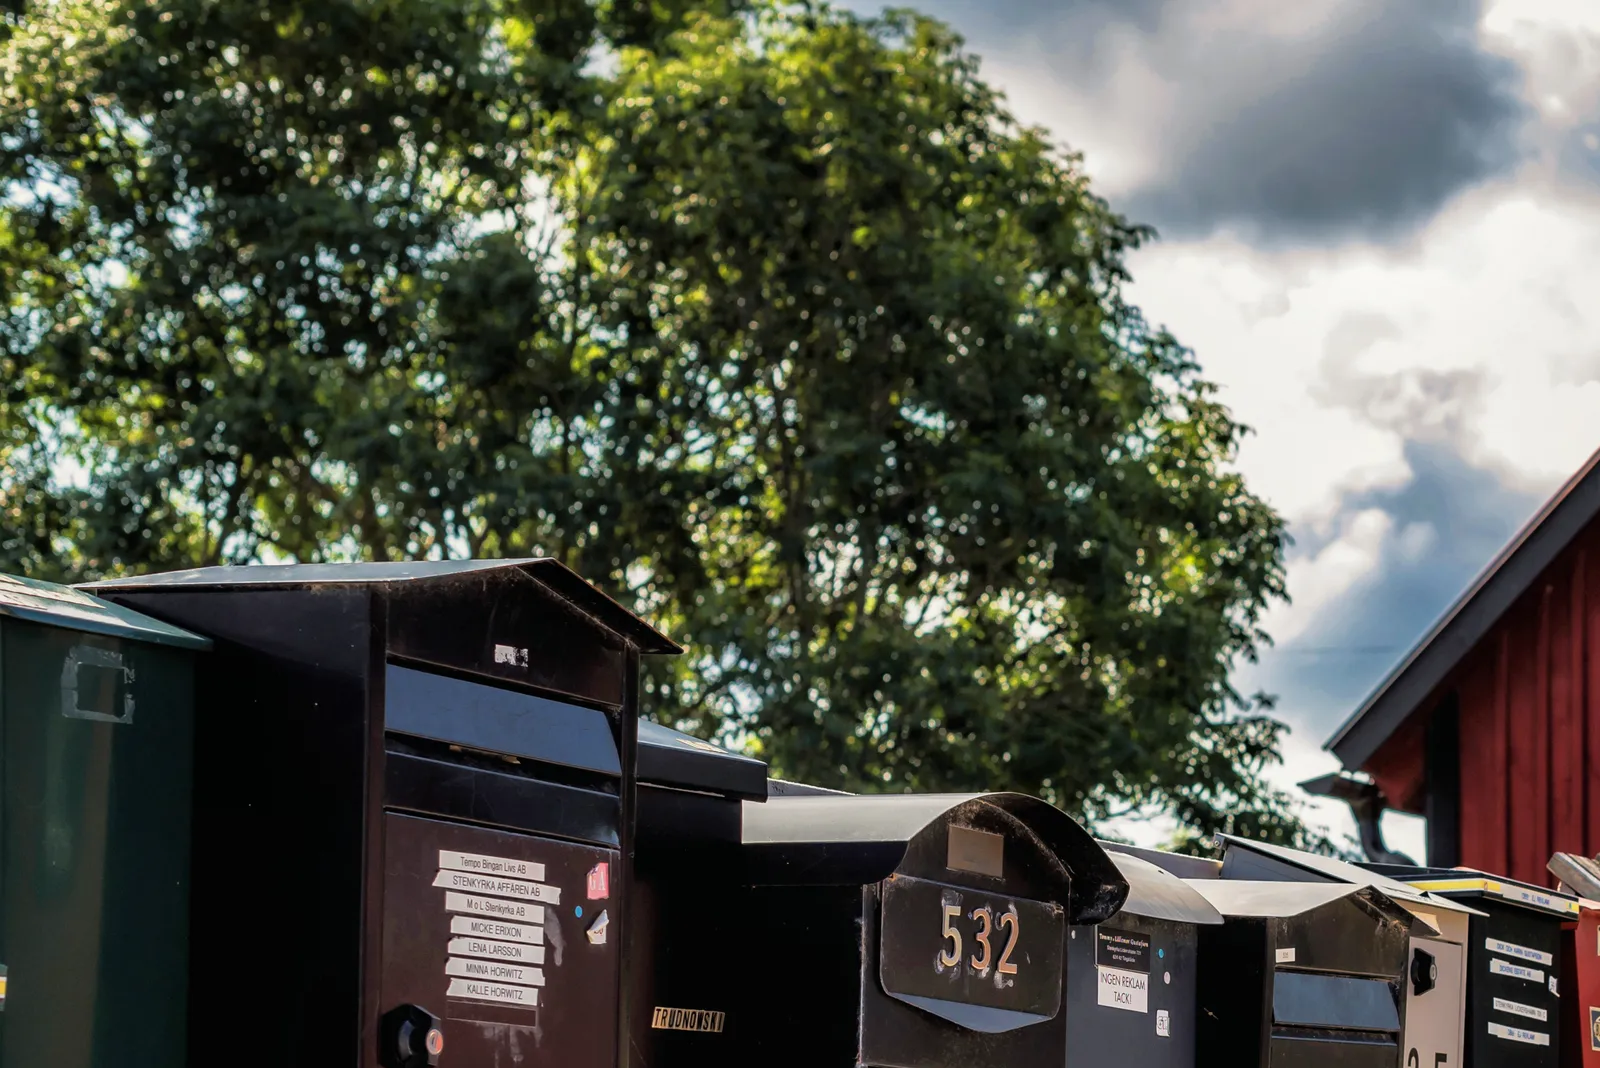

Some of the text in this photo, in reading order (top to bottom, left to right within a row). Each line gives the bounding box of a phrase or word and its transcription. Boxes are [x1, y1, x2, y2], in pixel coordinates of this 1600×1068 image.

[460, 856, 526, 874] Tempo Bingan Livs AB
[453, 875, 495, 891] STENKYRKA
[530, 886, 540, 897] AB
[467, 898, 473, 908] M
[474, 902, 479, 910] o
[485, 901, 514, 916] Stenkyrka
[516, 906, 525, 916] AB
[471, 922, 521, 938] MICKE ERIXON
[940, 905, 1019, 974] 532
[468, 942, 522, 957] LENA LARSSON
[466, 963, 523, 979] MINNA HORWITZ
[1101, 972, 1146, 991] INGEN REKLAM
[467, 984, 523, 1000] KALLE HORWITZ
[1114, 991, 1132, 1005] TACK!
[654, 1008, 723, 1031] TRUDNOWSKI
